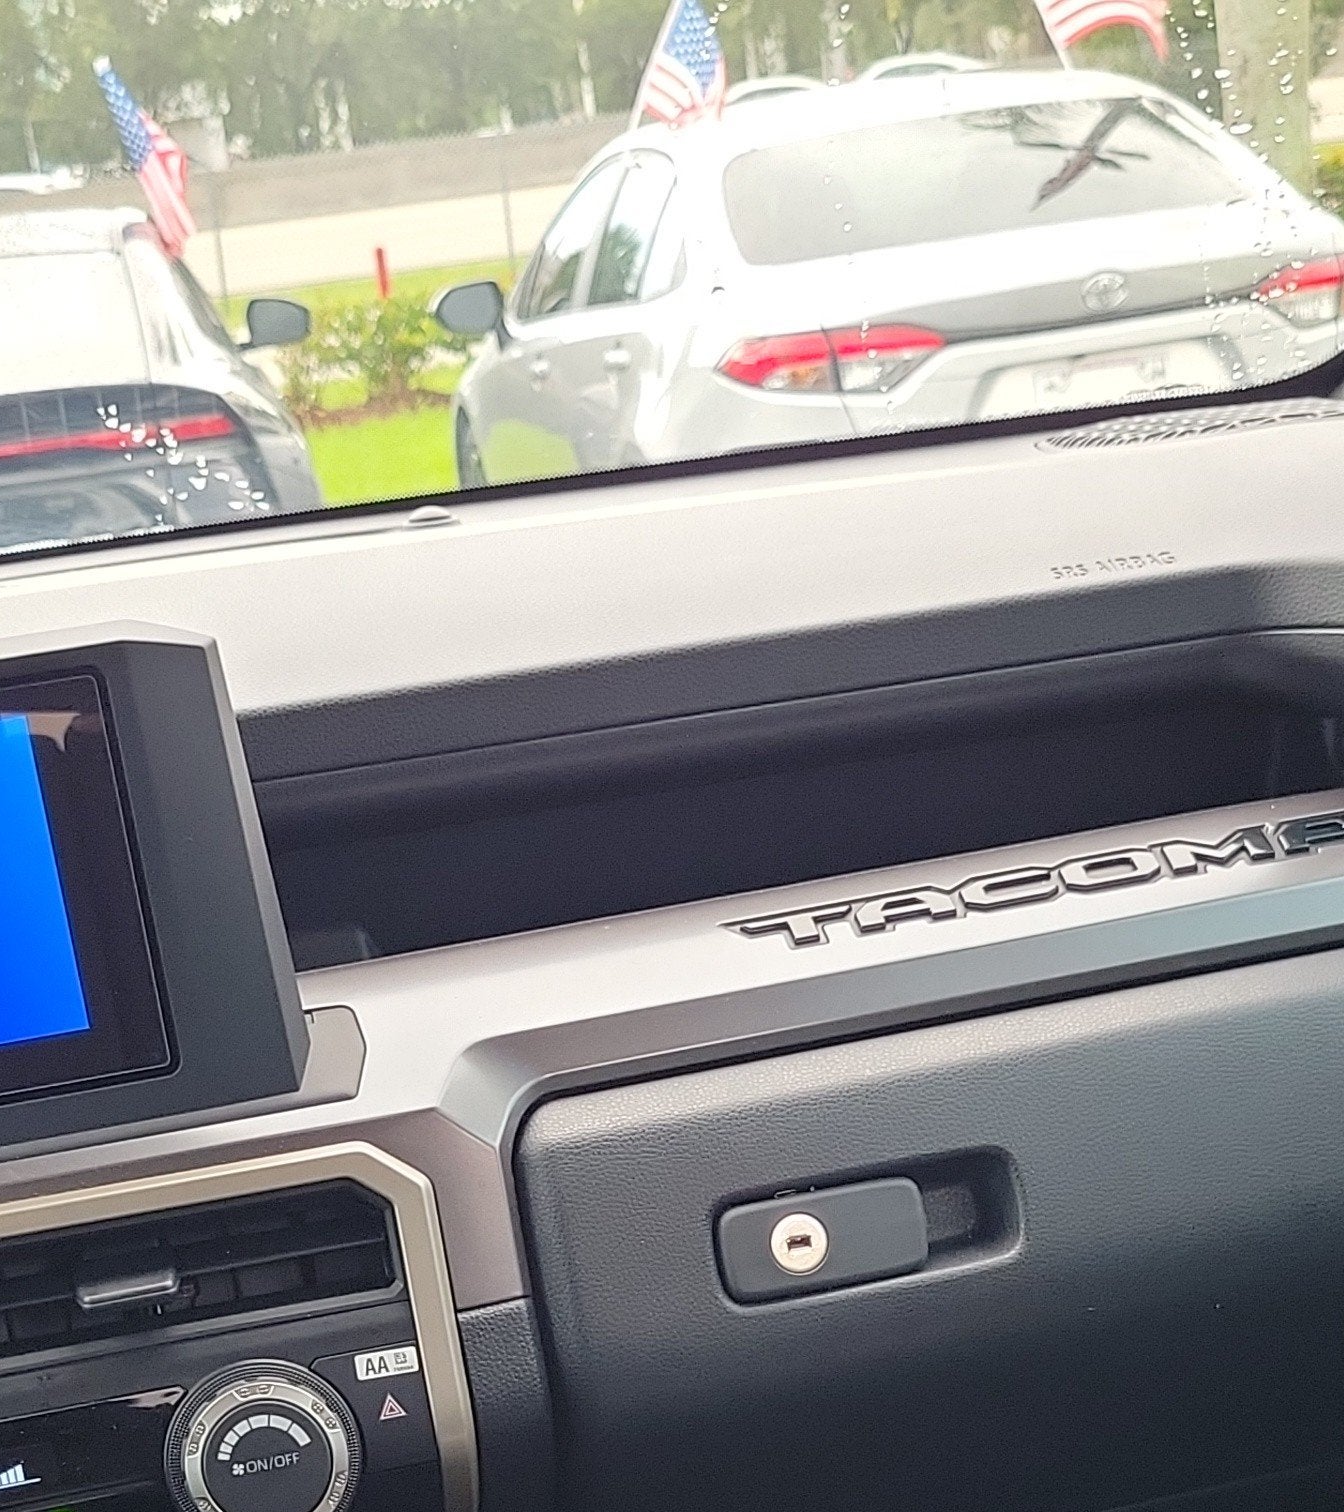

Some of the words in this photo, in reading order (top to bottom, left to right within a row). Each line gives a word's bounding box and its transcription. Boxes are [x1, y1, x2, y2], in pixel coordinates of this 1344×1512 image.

[1050, 564, 1088, 579] SRS
[1095, 551, 1175, 572] AIRBAG
[365, 1356, 390, 1376] AA
[246, 1451, 301, 1473] ON/OFF
